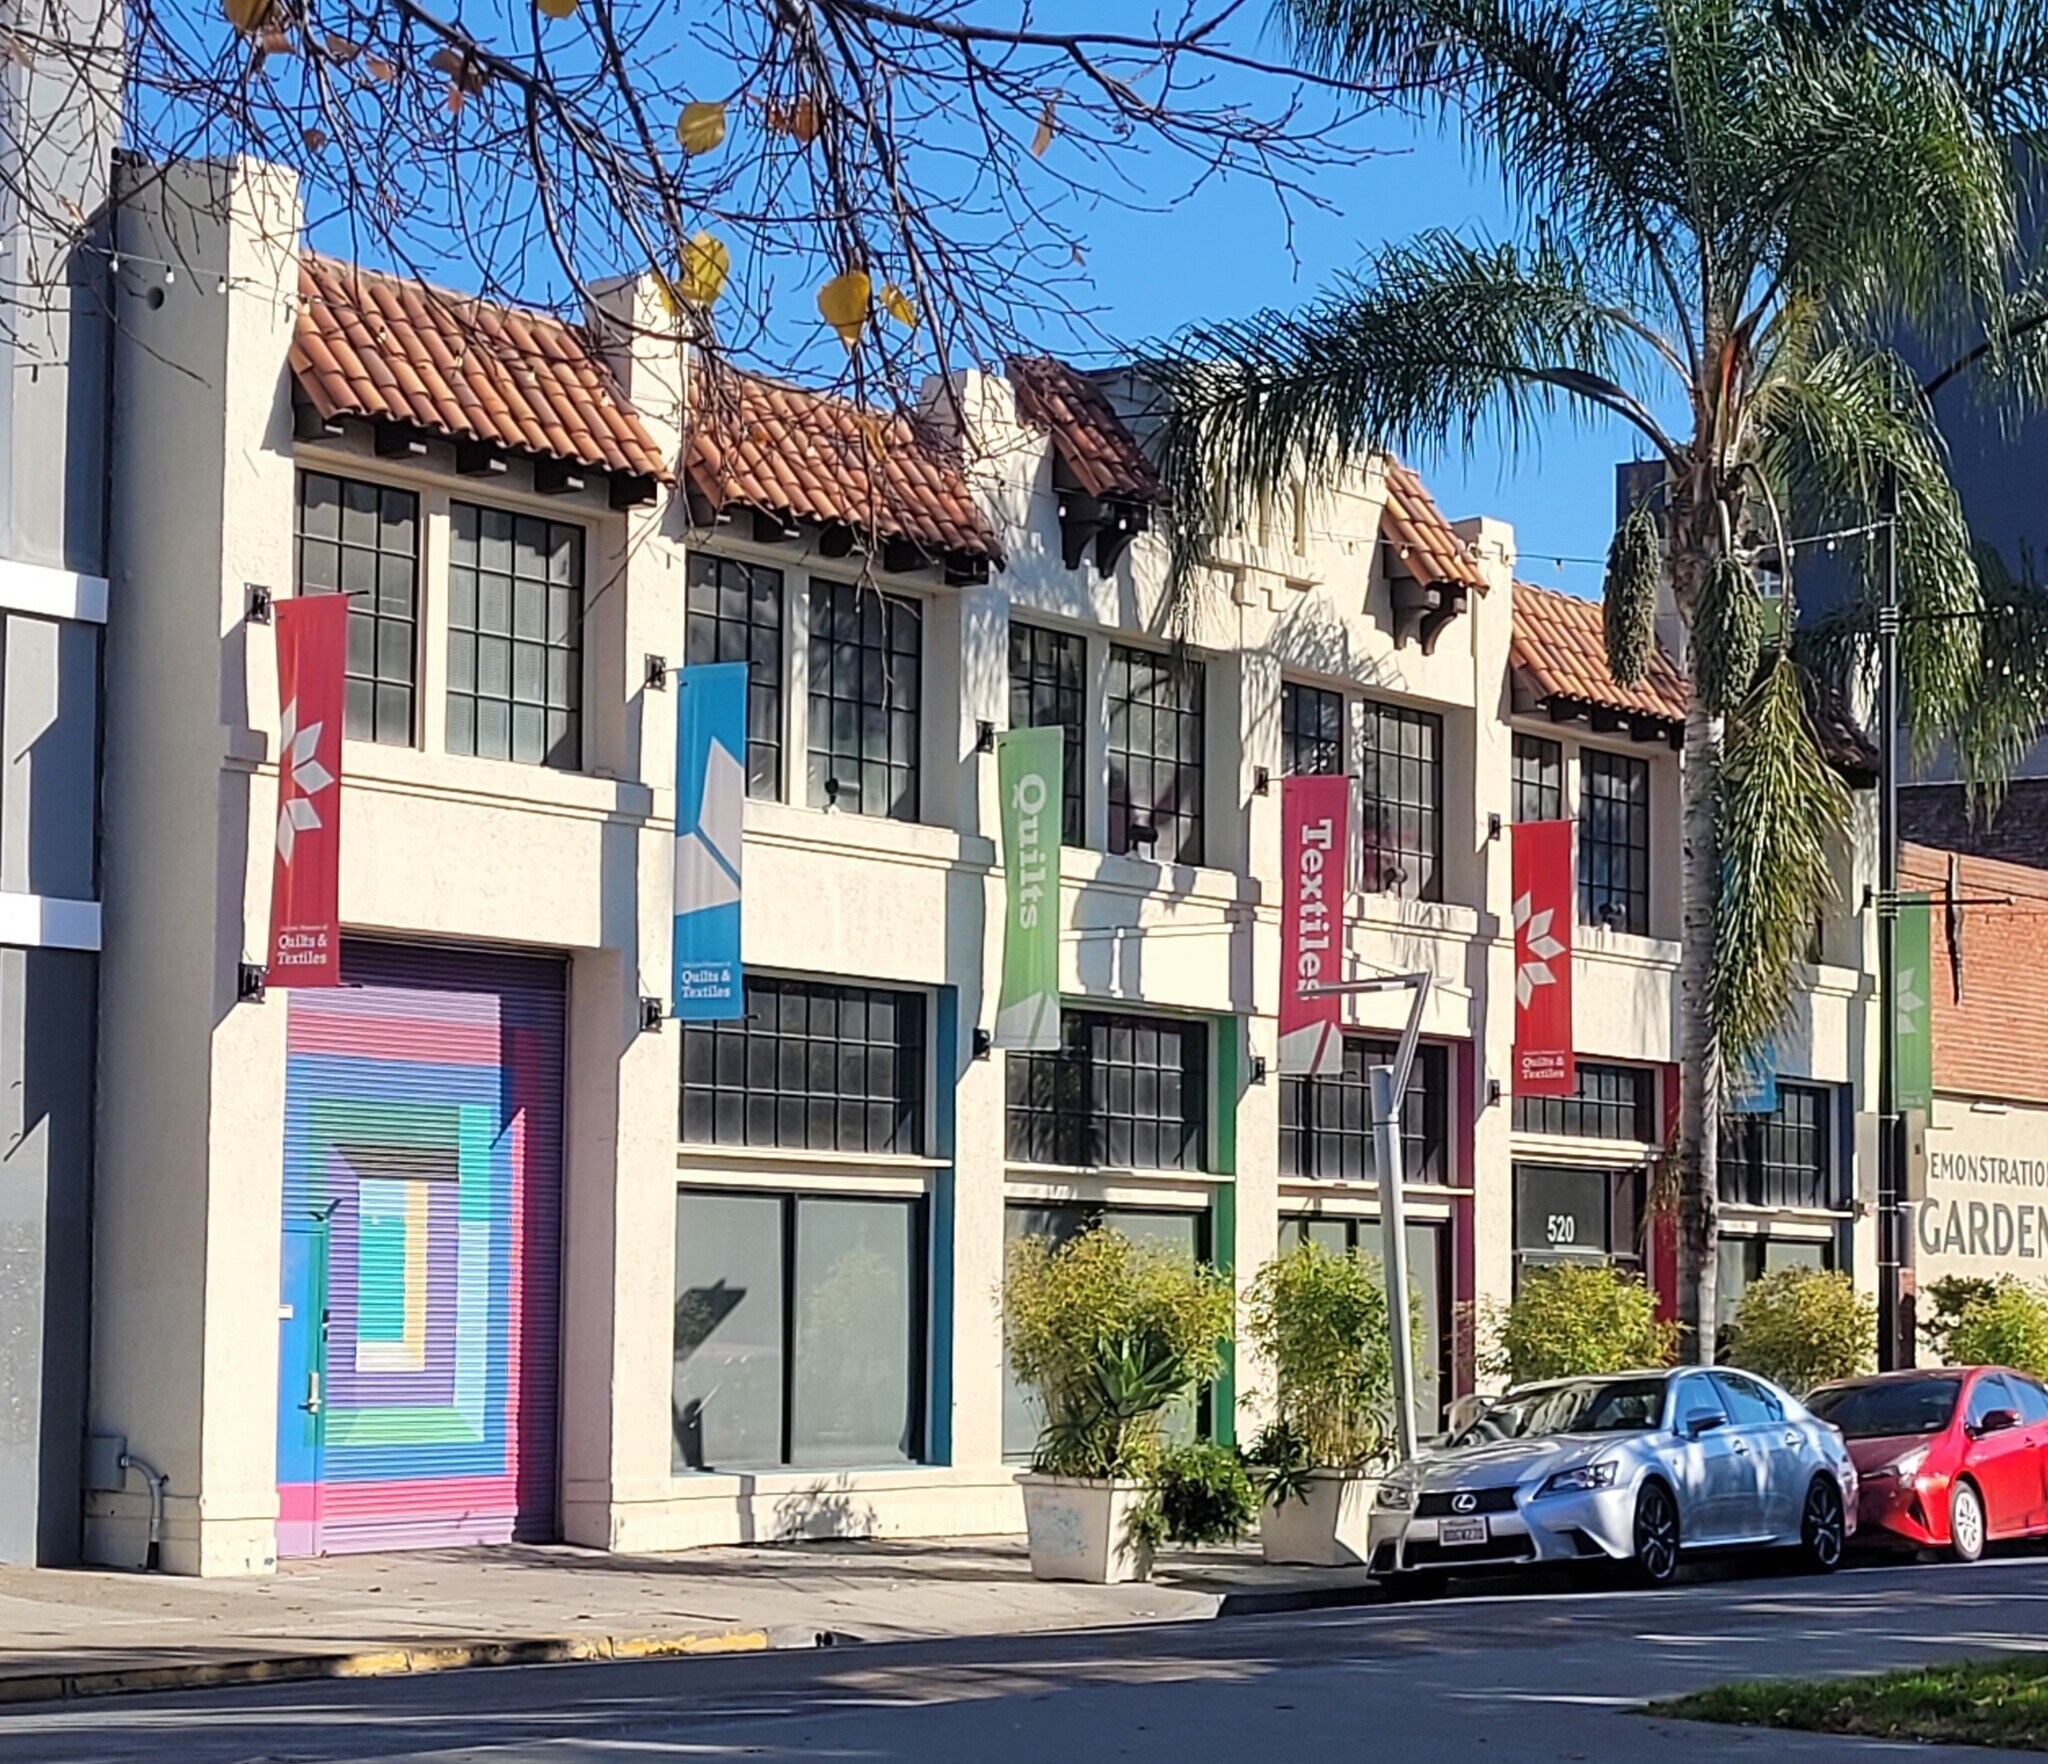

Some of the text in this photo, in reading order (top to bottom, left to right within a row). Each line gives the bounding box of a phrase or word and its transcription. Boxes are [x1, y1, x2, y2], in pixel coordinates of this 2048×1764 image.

[1012, 773, 1047, 929] Quilts
[1297, 819, 1333, 1001] Textiles
[278, 933, 327, 950] Quilts &
[277, 951, 327, 965] Textiles
[682, 970, 719, 984] Quilts
[681, 985, 731, 998] Textiles
[1930, 1152, 2048, 1187] EMONSTRATIO
[1547, 1214, 1575, 1243] 520
